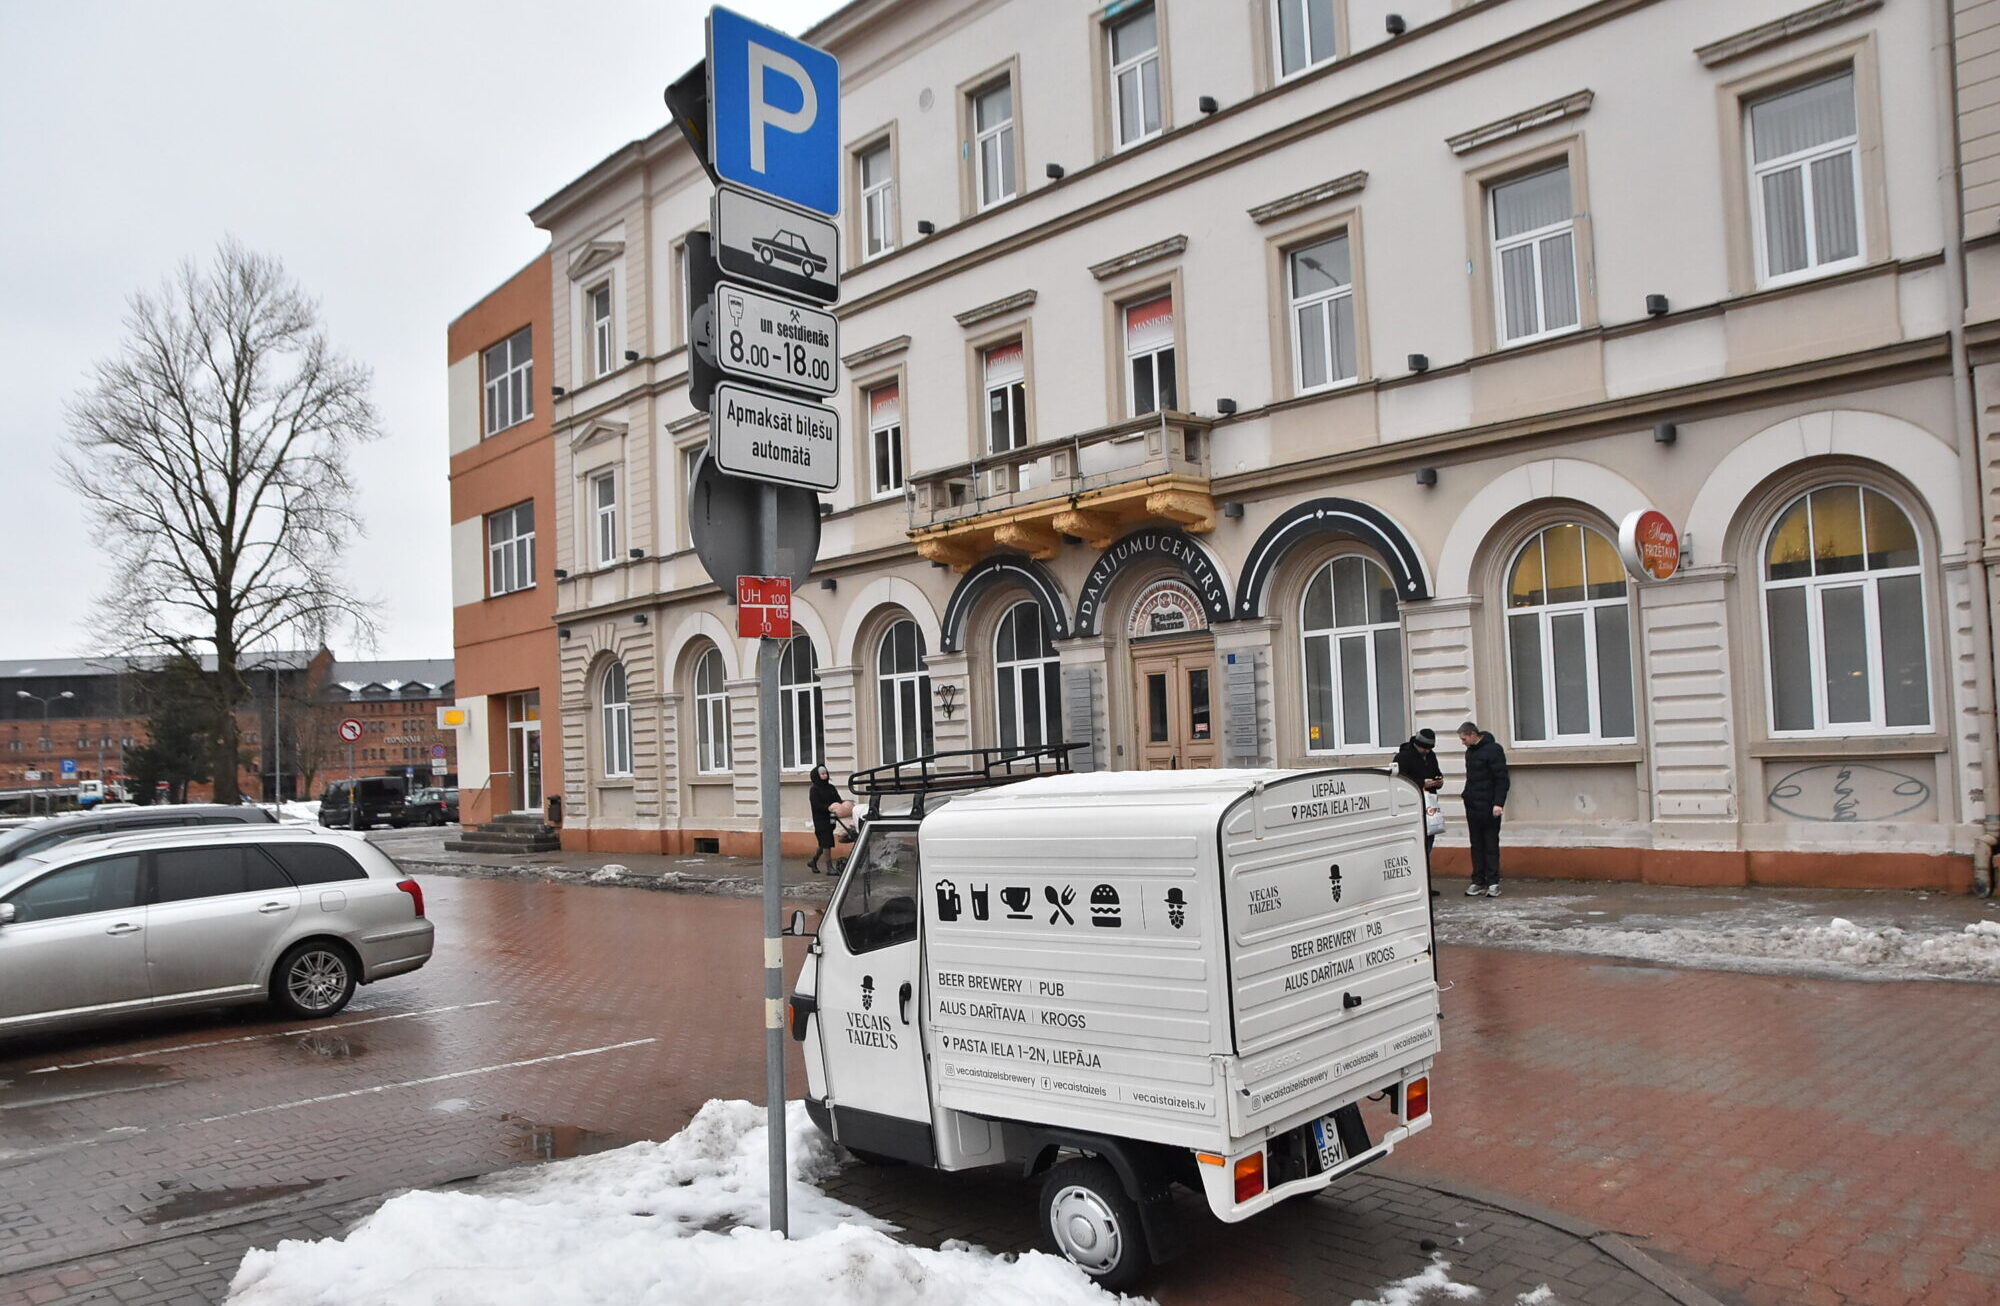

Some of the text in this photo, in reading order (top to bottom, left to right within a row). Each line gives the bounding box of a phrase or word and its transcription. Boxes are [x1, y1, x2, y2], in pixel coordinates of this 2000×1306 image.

[748, 40, 818, 174] P
[760, 318, 829, 348] un sestdienās
[727, 399, 833, 442] Apmaksāt biļešu
[752, 440, 811, 467] automātā
[741, 588, 786, 605] UH 100
[760, 621, 772, 633] 10
[1150, 611, 1184, 622] Pasta
[1312, 779, 1346, 798] LIEPĀJA
[1300, 796, 1370, 819] PASTA IELA 1-2N
[1384, 855, 1409, 869] VECAIS
[1250, 885, 1279, 902] VECAIS
[1248, 897, 1282, 916] TAIZEL'S
[1291, 921, 1383, 960] BEER BREWERY PUB
[1284, 947, 1395, 992] ALUS DARĪTAVA KROGS
[938, 972, 1065, 997] BEER BREWERY PUB
[846, 1012, 892, 1032] VECAIS
[939, 1000, 1087, 1029] ALUS DARĪTAVA KROGS
[845, 1029, 899, 1050] TAIZEL'S
[953, 1037, 1102, 1069] PASTA IELA 1-2N, LIEPĀJA
[1261, 1028, 1433, 1104] vecaistaizelsbrewery vecaistaizels vecaistaizels.lv
[956, 1066, 1206, 1111] vecaistaizelsbrewery vecaistaizels vecaistaizels.lv
[1326, 1122, 1334, 1140] S
